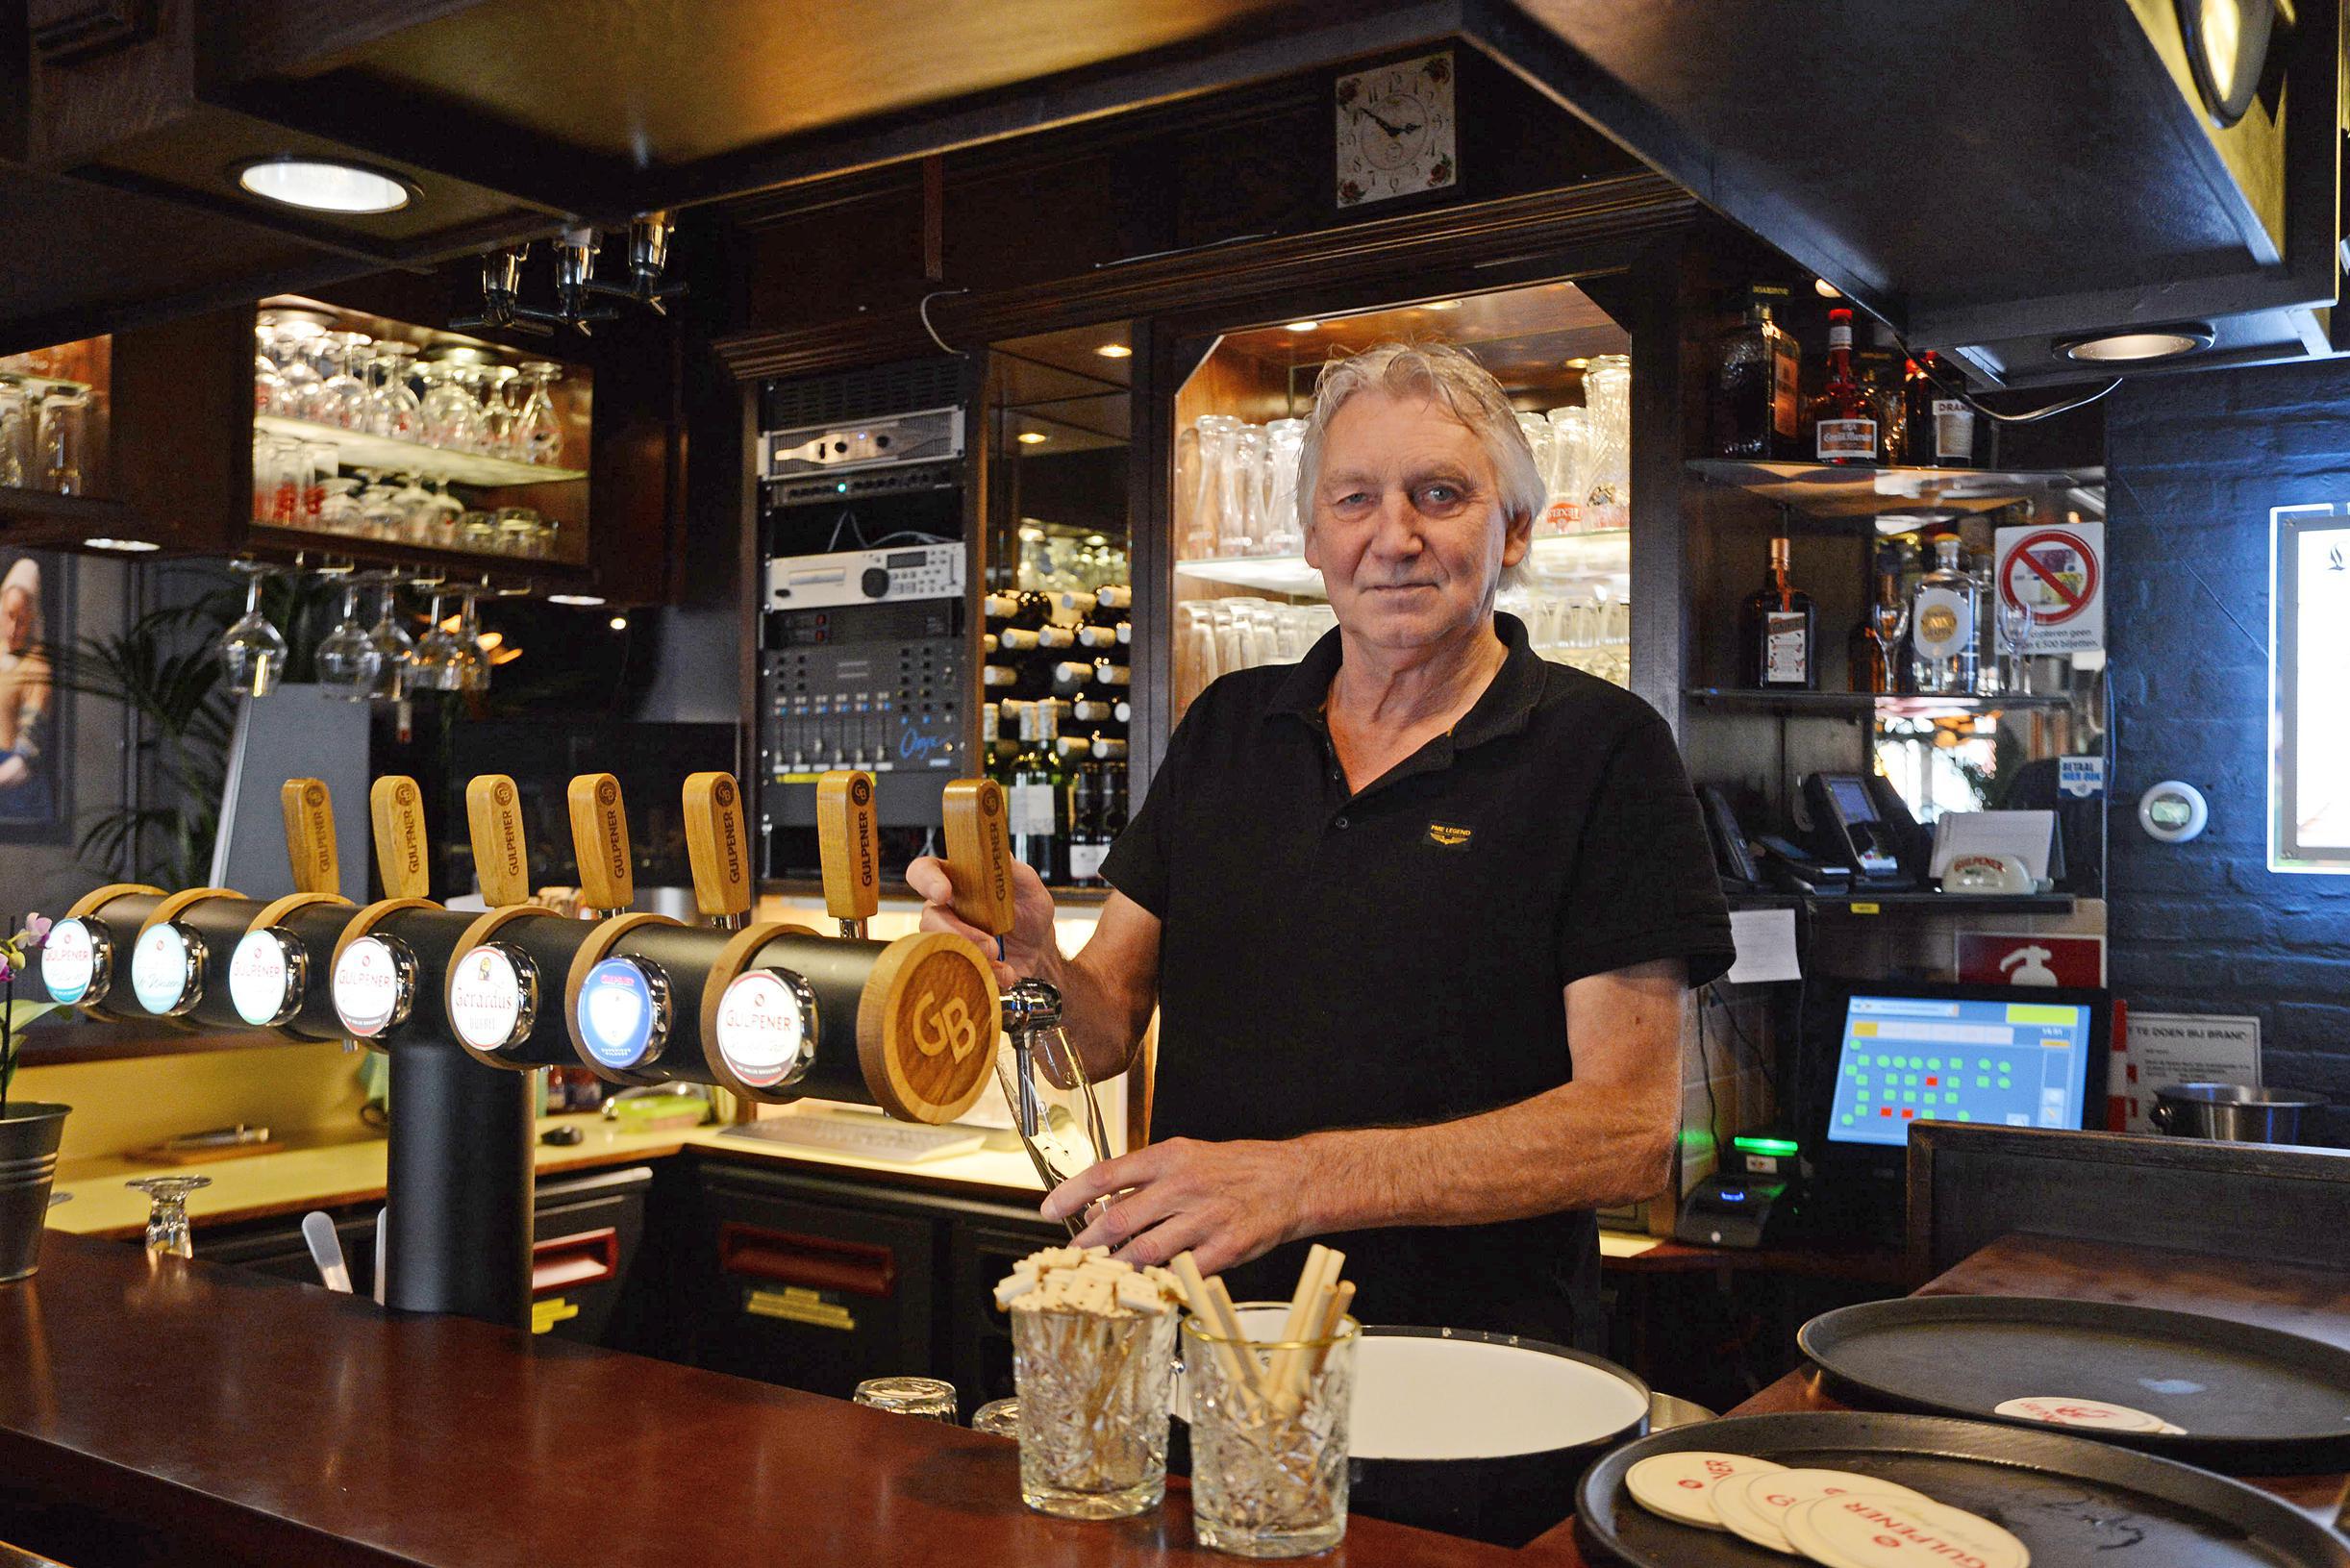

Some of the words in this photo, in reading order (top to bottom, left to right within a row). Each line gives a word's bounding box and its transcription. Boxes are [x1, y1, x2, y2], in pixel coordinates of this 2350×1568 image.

[313, 810, 331, 873] GULPENER
[403, 809, 419, 873] GULPENER
[502, 809, 519, 876] GULPENER
[607, 809, 624, 879] GULPENER
[723, 811, 740, 884] GULPENER
[859, 811, 872, 887] GULPENER
[989, 821, 1006, 901] GULPENER
[1446, 827, 1471, 836] LEGEND
[234, 962, 281, 979] GULPENER
[338, 970, 391, 988] GULPENER
[456, 986, 512, 1009] Gerardus
[726, 1009, 791, 1032] GULPENER
[912, 991, 976, 1064] GB
[1844, 1502, 1989, 1568] GULPENER
